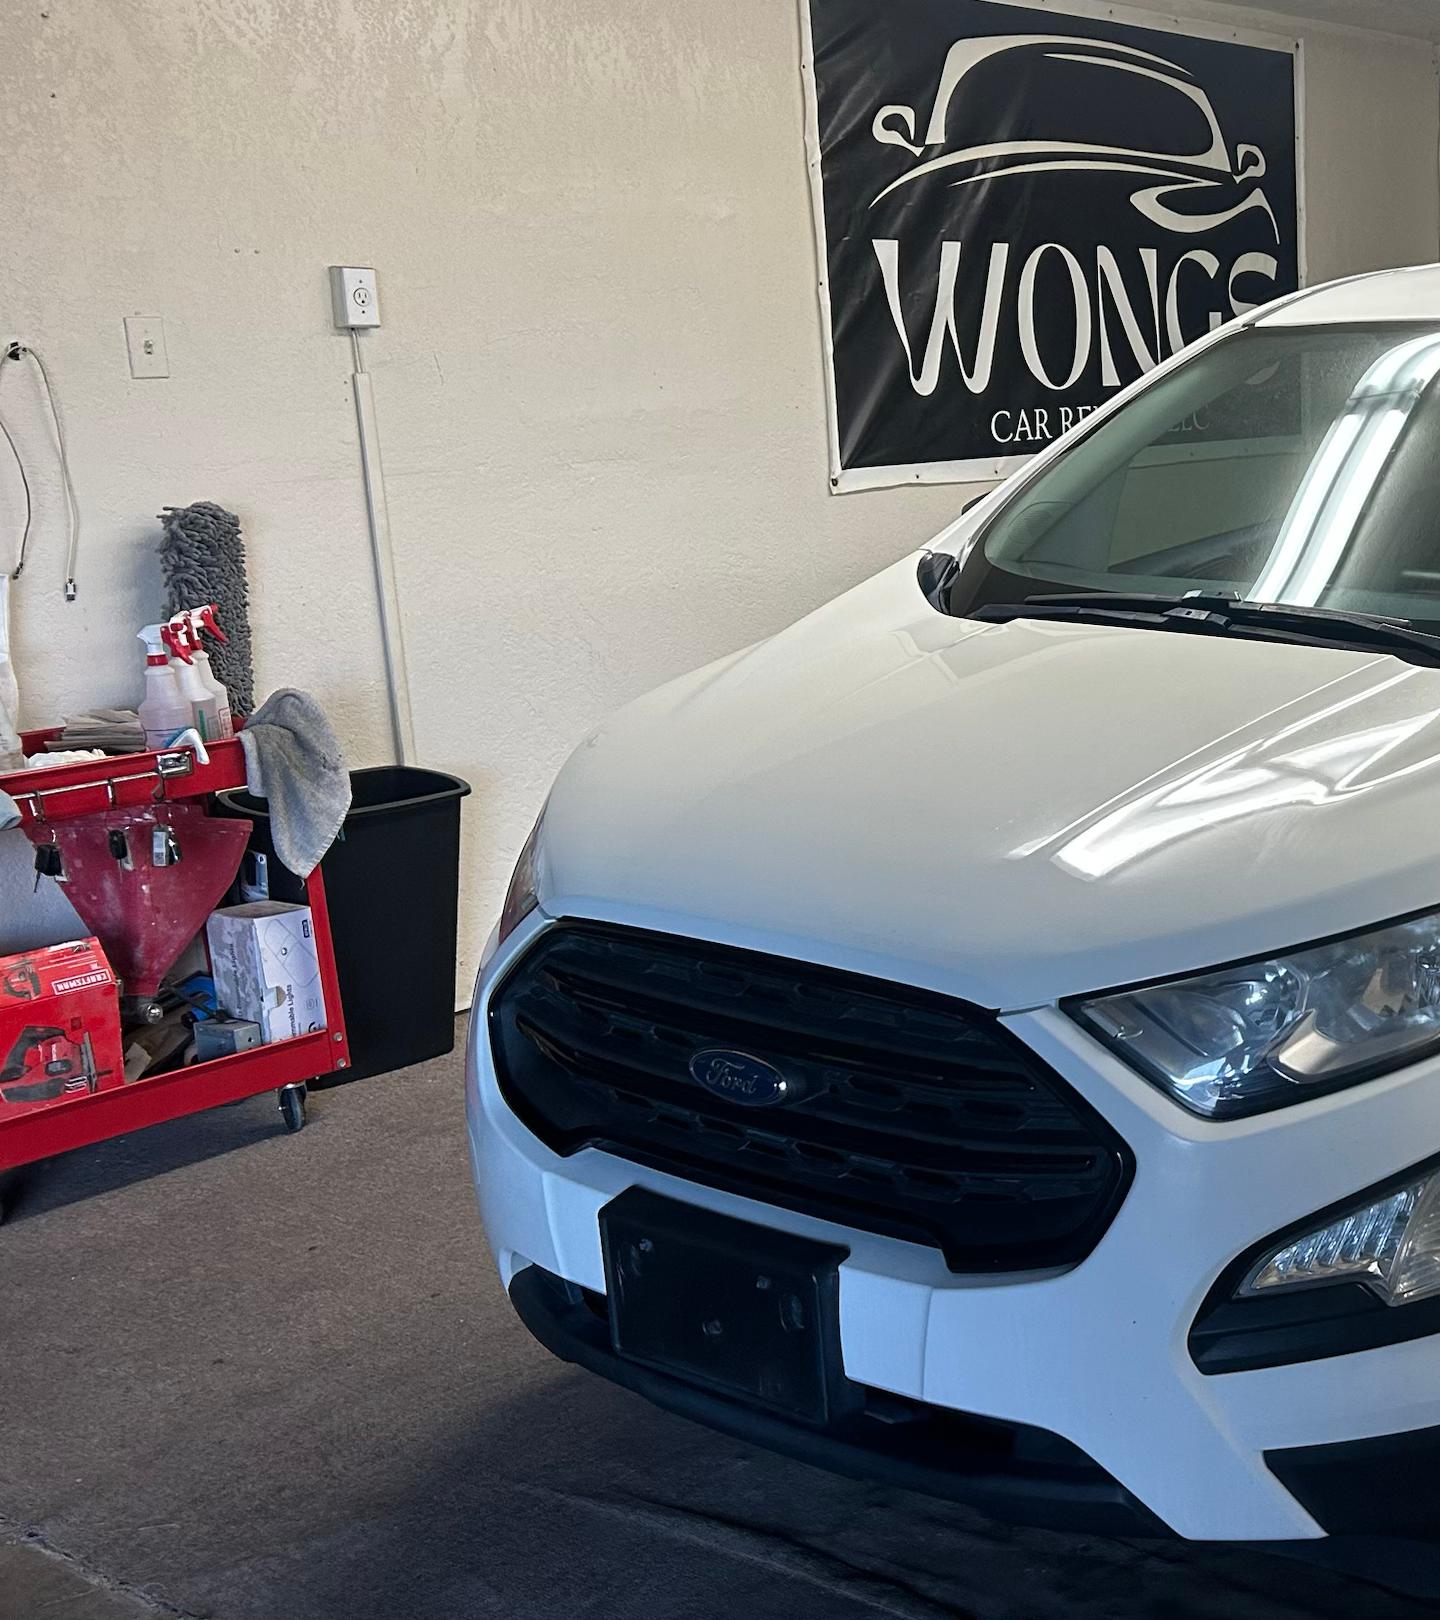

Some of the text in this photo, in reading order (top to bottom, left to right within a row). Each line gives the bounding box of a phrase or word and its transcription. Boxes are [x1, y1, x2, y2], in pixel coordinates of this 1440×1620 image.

[871, 238, 1278, 396] WONGS
[990, 408, 1053, 444] CAR
[56, 972, 108, 992] CRAFTSMAN
[286, 984, 295, 1006] Lights
[706, 1058, 759, 1094] Ford
